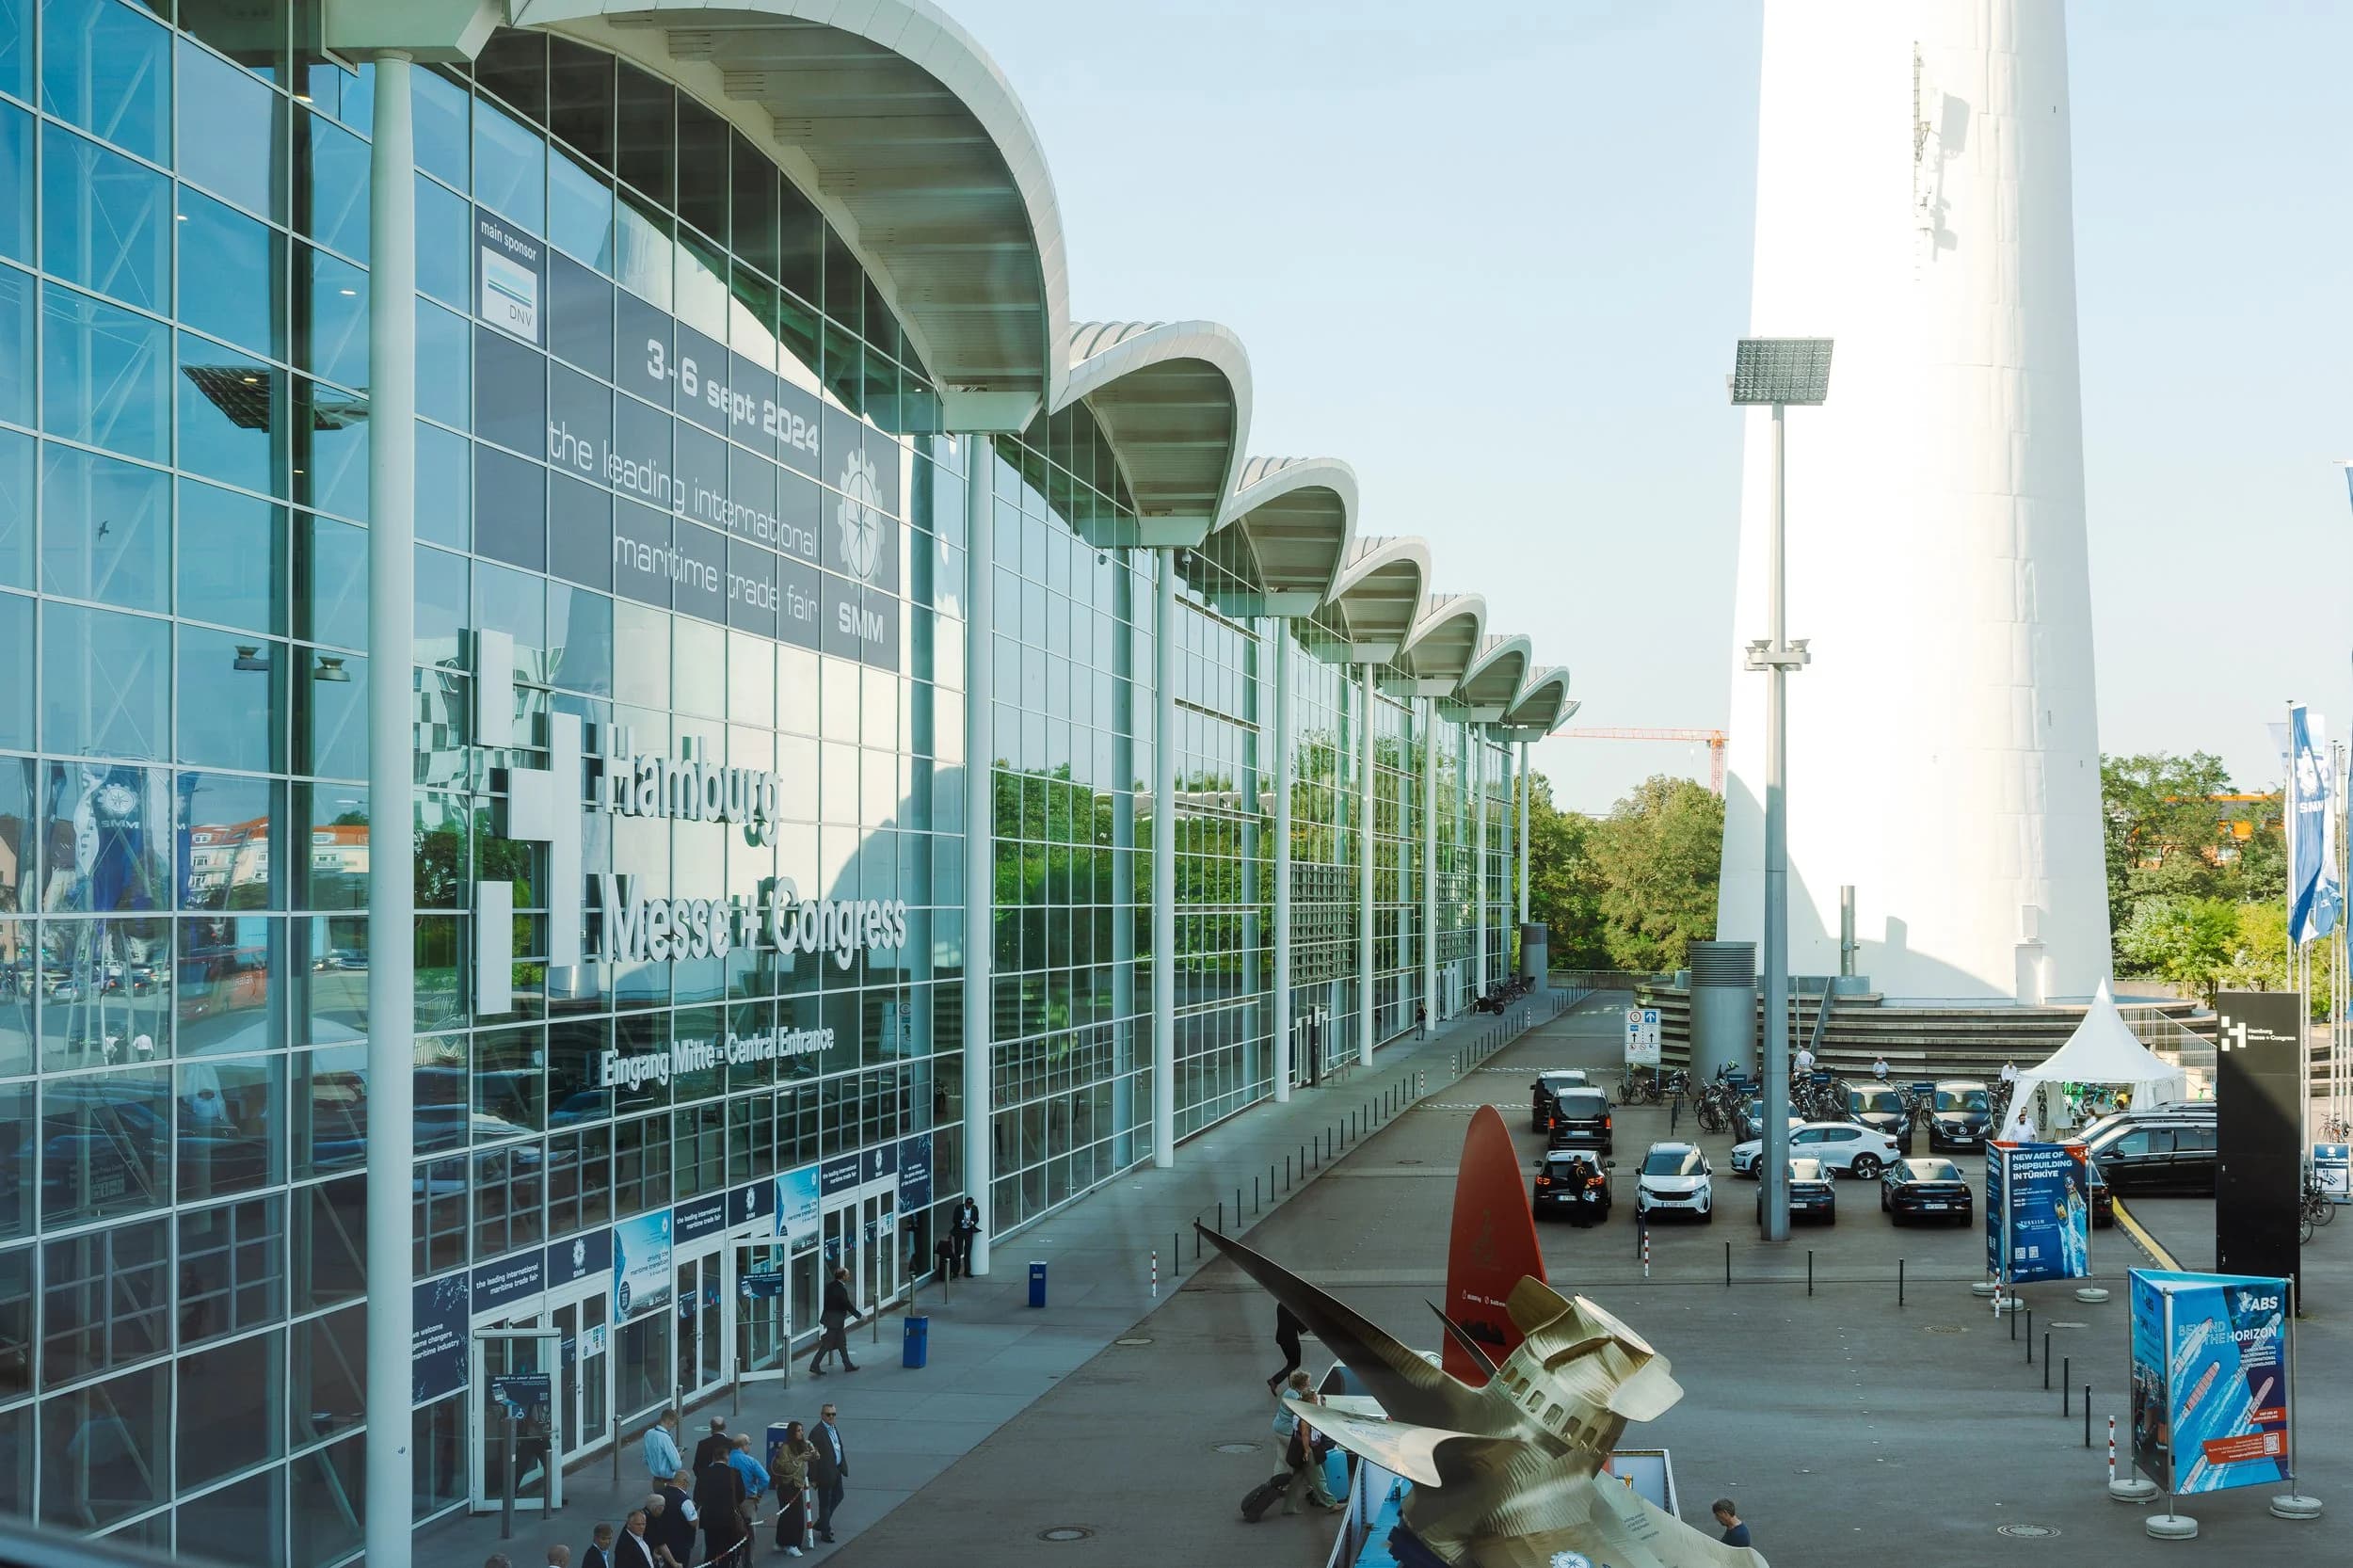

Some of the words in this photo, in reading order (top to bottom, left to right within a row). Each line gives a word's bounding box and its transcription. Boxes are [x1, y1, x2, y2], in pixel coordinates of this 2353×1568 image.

[481, 220, 503, 243] main
[504, 233, 536, 262] sponsor
[509, 304, 532, 328] DNV
[707, 380, 756, 426] sept
[763, 399, 819, 457] 2024
[549, 420, 593, 470] the
[603, 440, 685, 516] leading
[695, 477, 817, 558] international
[614, 535, 718, 593] maritime
[726, 570, 779, 612] trade
[787, 584, 817, 623] fair
[839, 601, 884, 645] SMM
[604, 722, 780, 847] Hamburg
[599, 873, 729, 964] Messe
[773, 876, 906, 970] Congress
[600, 1048, 669, 1091] Eingang
[671, 1038, 714, 1074] Mitte
[725, 1029, 776, 1065] Central
[777, 1024, 834, 1058] Entrance
[2013, 1153, 2033, 1161] NEW
[2033, 1152, 2051, 1160] AGE
[2013, 1160, 2073, 1171] SHIPBUILDING
[476, 1281, 486, 1290] the
[487, 1274, 505, 1286] leading
[506, 1262, 539, 1280] international
[490, 1282, 513, 1295] maritime
[514, 1277, 528, 1287] trade
[529, 1272, 538, 1282] fair
[573, 1268, 585, 1278] SMM
[2250, 1296, 2278, 1312] ABS
[421, 1323, 443, 1336] welcome
[428, 1331, 452, 1345] changers
[2178, 1320, 2226, 1336] BEND
[2205, 1332, 2226, 1345] THE
[2227, 1327, 2277, 1343] HORIZON
[438, 1339, 460, 1352] industry
